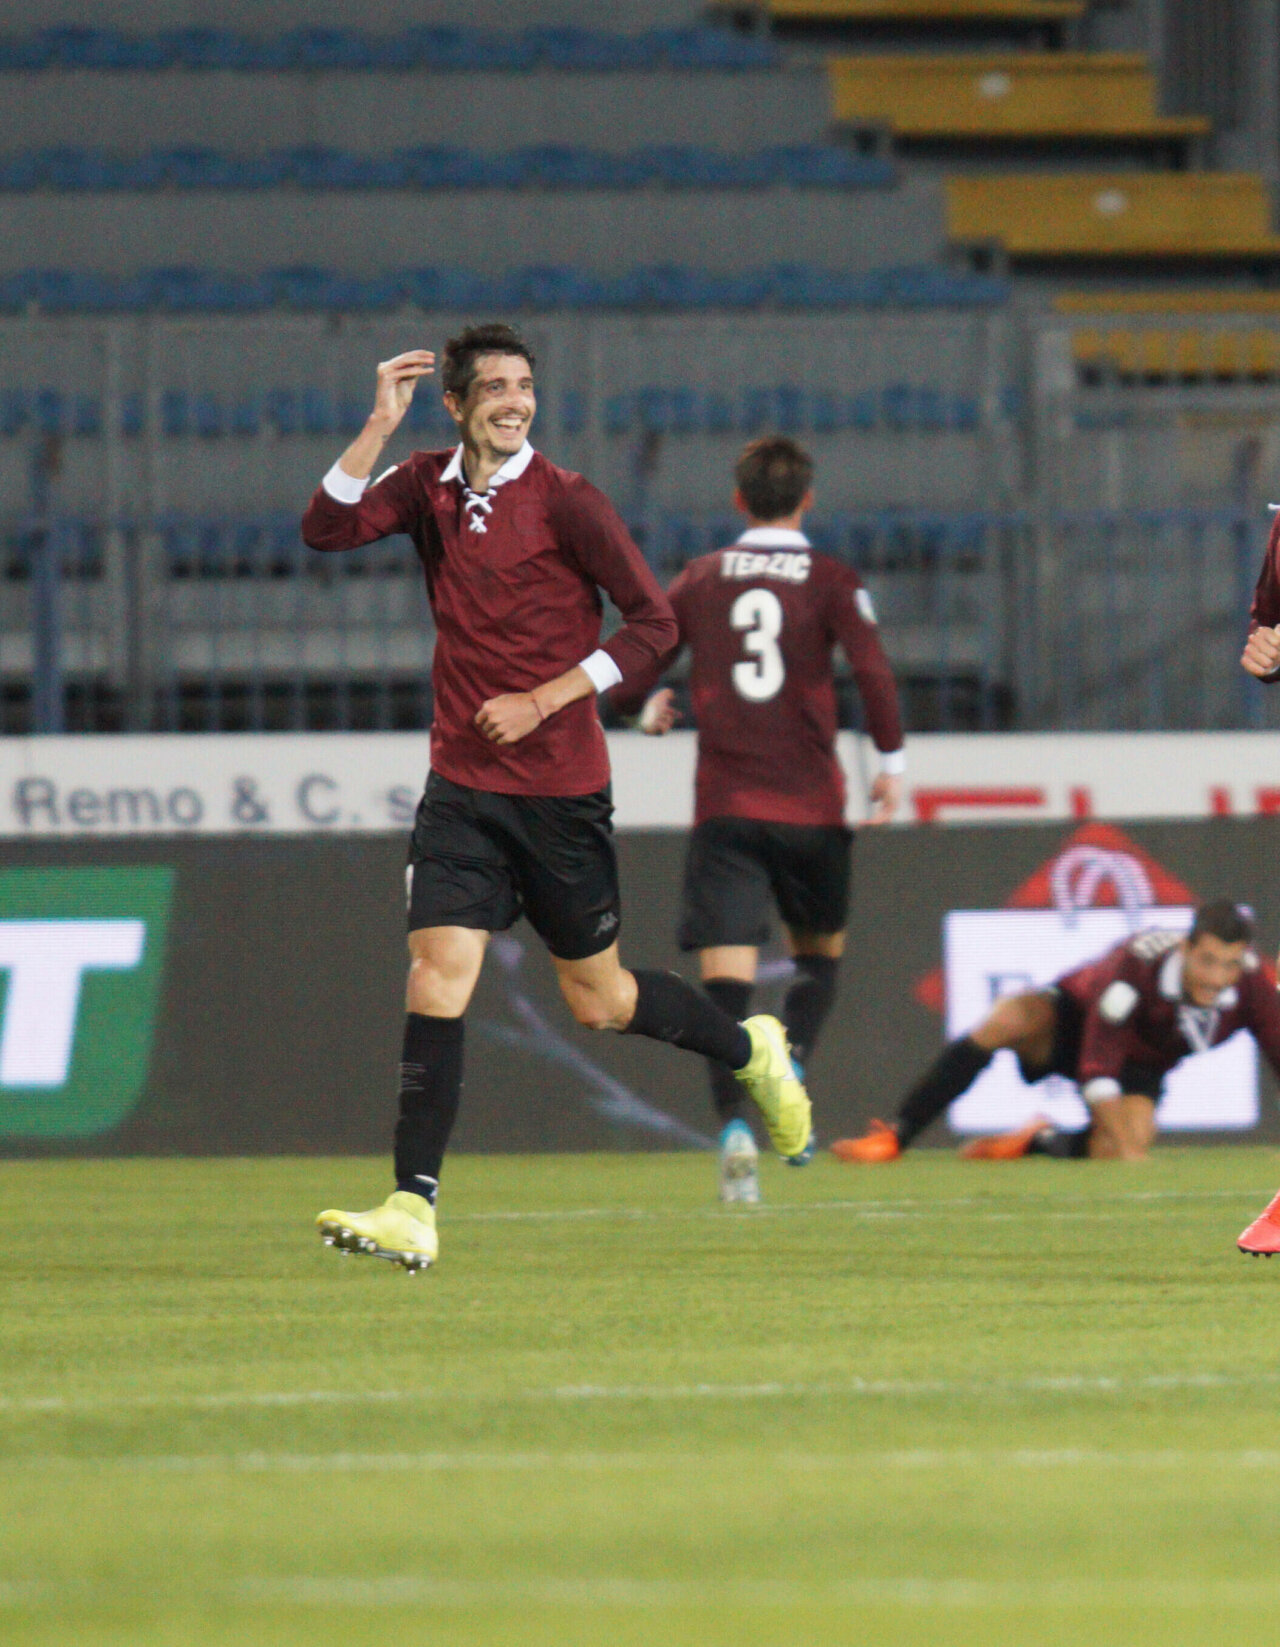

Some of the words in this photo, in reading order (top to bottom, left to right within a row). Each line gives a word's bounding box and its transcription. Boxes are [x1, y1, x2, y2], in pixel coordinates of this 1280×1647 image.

[731, 588, 786, 702] 3
[14, 775, 205, 825] Remo
[231, 775, 269, 824] &
[299, 773, 363, 824] C.
